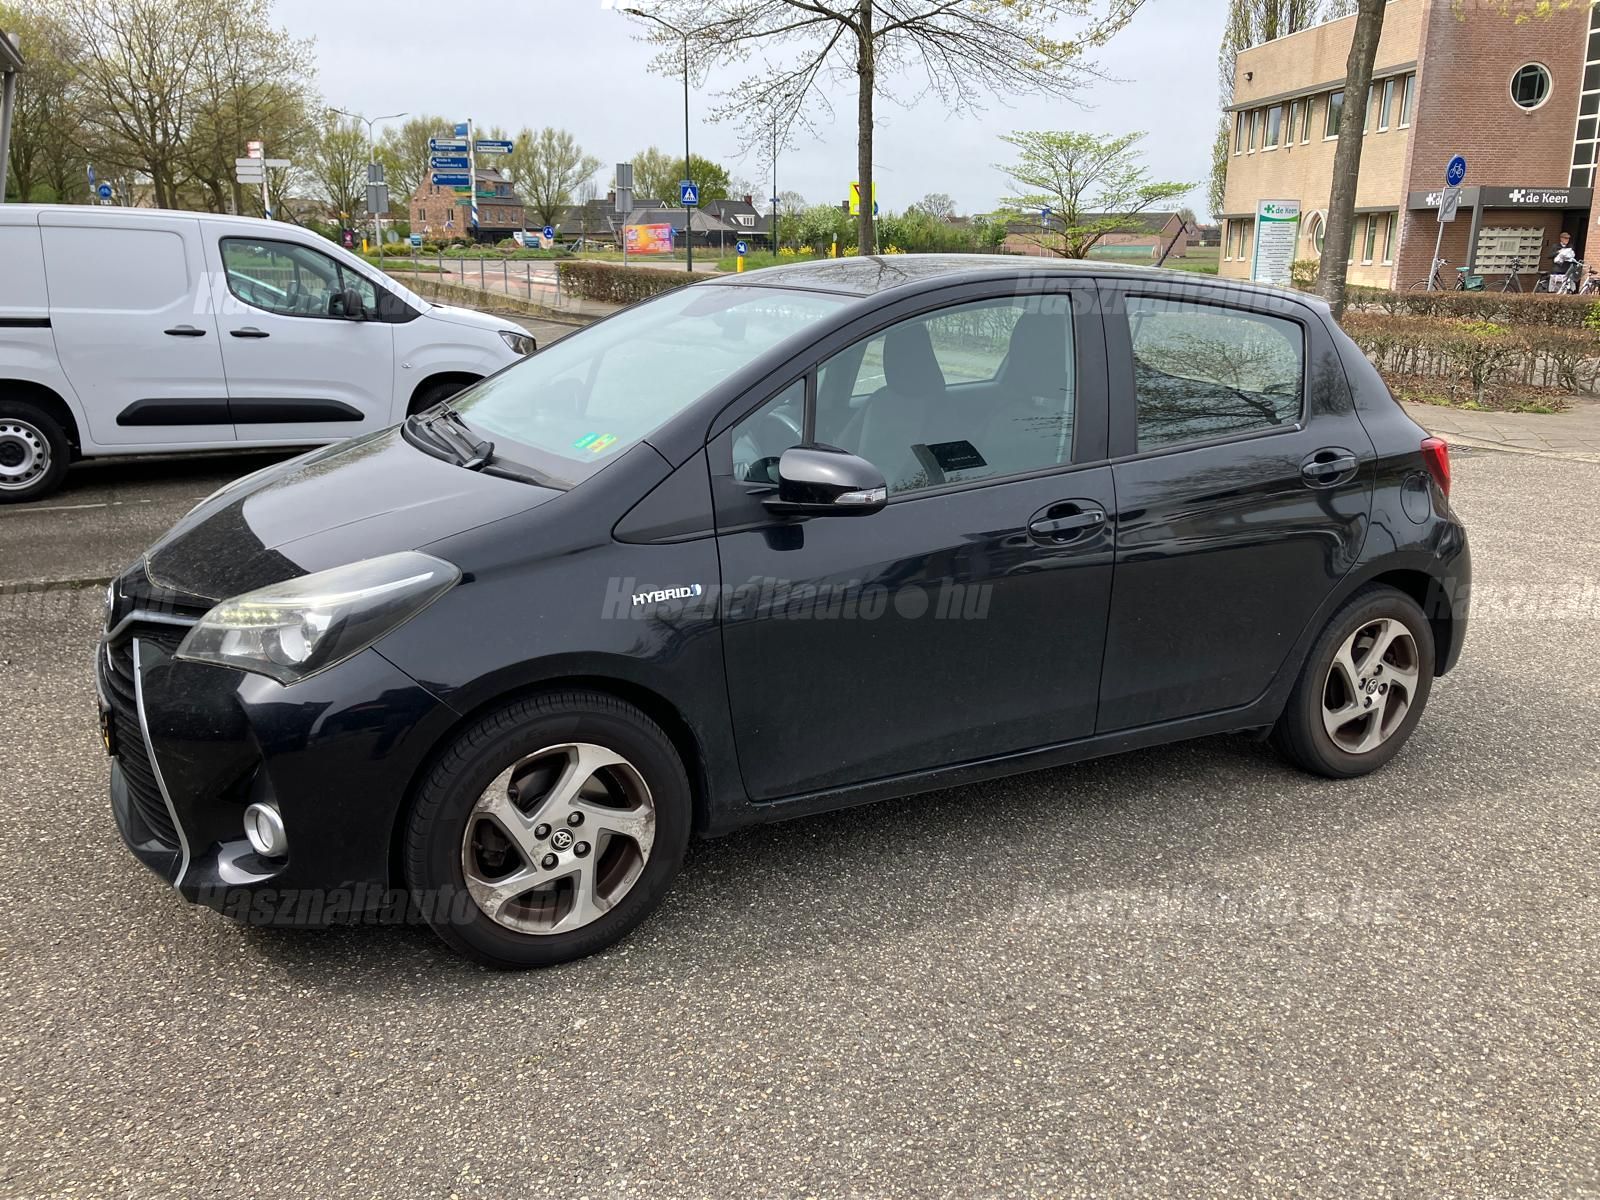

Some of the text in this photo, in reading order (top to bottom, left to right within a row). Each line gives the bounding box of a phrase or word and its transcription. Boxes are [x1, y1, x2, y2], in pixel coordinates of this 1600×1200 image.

[1526, 193, 1568, 203] de Keen
[632, 587, 691, 606] HYBRID
